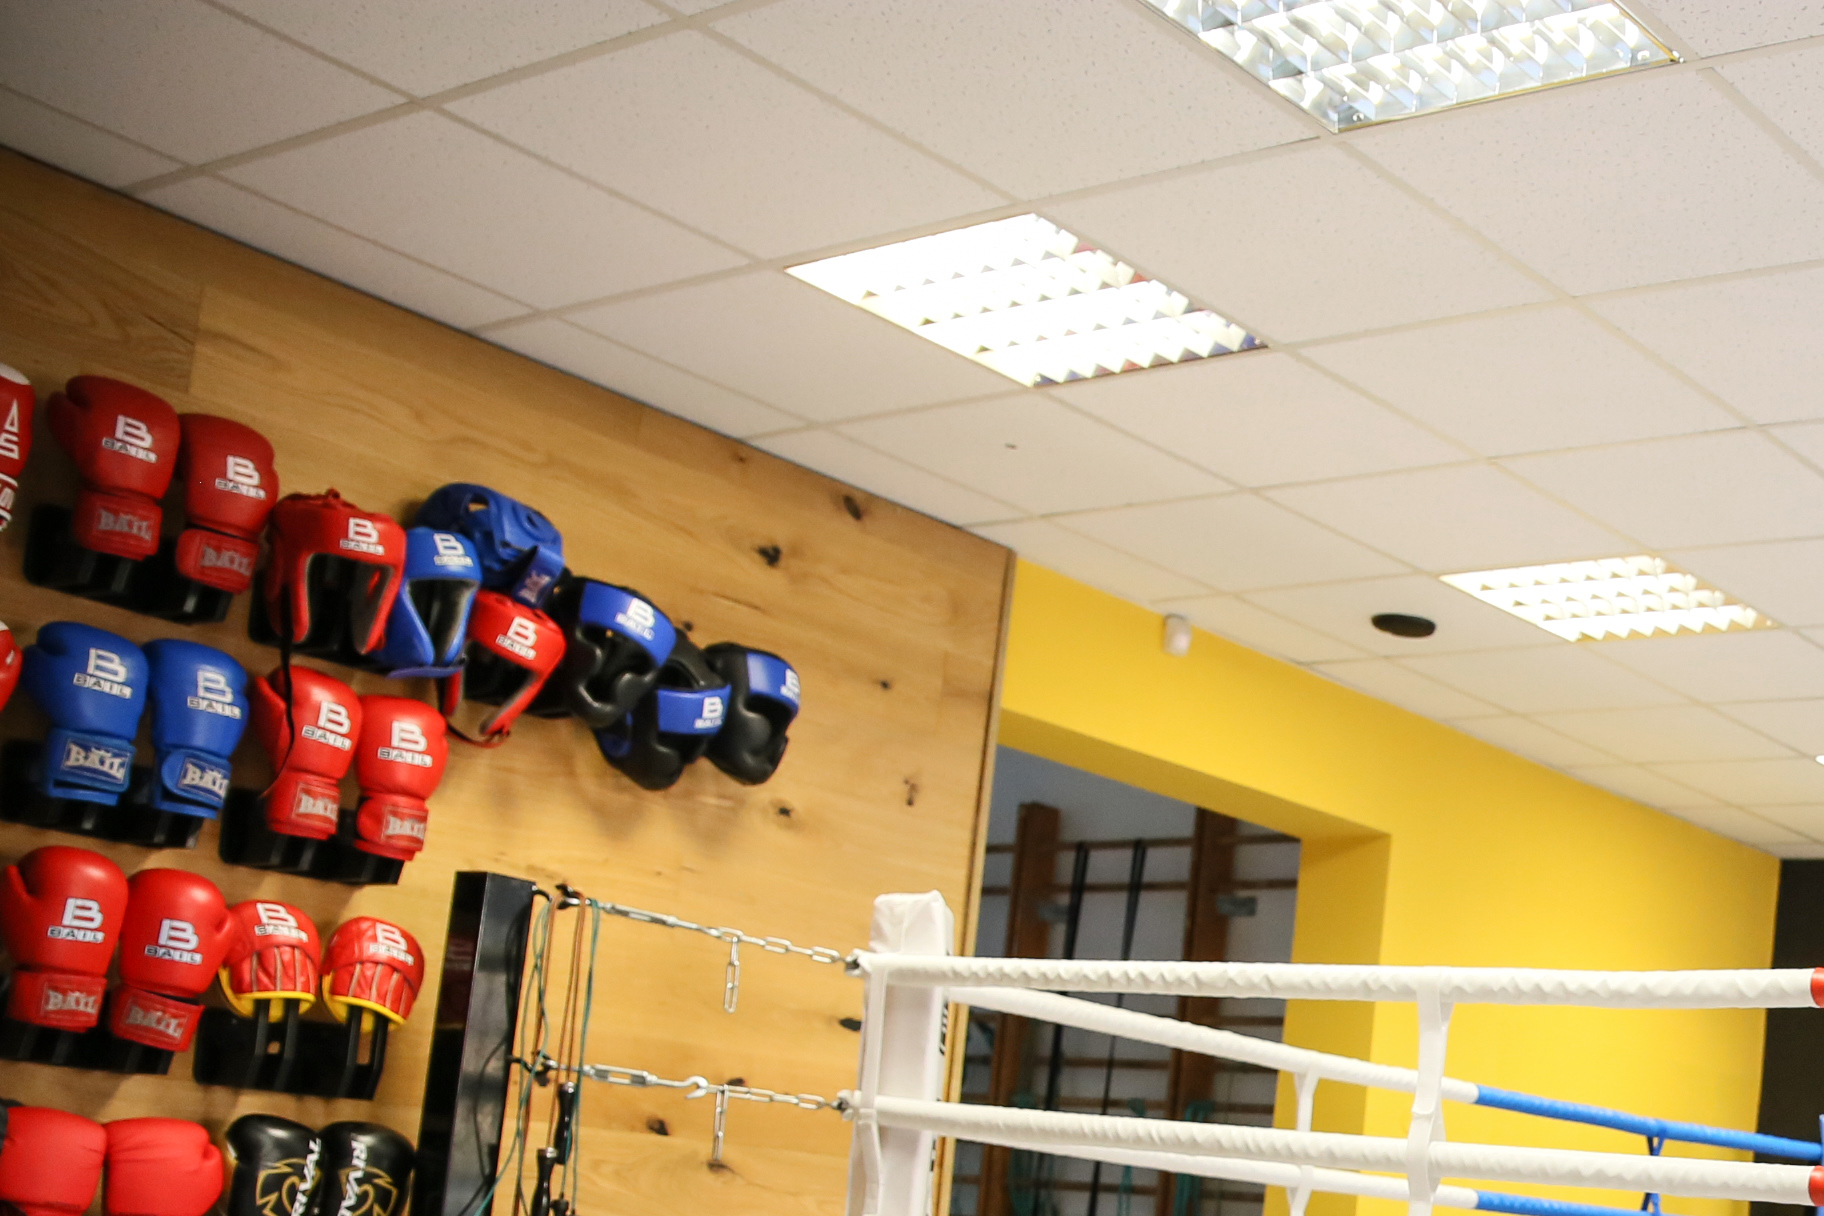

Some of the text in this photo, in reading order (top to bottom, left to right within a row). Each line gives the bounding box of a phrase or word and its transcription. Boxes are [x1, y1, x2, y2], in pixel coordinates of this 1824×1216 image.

[115, 414, 154, 449] B
[102, 437, 158, 463] BAIL
[226, 455, 260, 486] B
[215, 478, 266, 499] BAIL
[348, 517, 379, 543] B
[340, 539, 384, 555] BAIL
[433, 533, 465, 555] B
[626, 598, 655, 628] B
[508, 616, 538, 646] B
[87, 647, 127, 683] B
[73, 672, 133, 699] BAIL
[197, 670, 233, 703] B
[187, 696, 241, 720] BAIL
[317, 700, 351, 735] B
[702, 696, 723, 718] B
[302, 724, 352, 751] BAIL
[391, 720, 427, 752] B
[63, 743, 127, 781] BAIL
[378, 746, 433, 768] BAIL
[62, 897, 104, 930] B
[256, 902, 298, 928] B
[47, 925, 105, 944] BAIL
[158, 918, 199, 951] B
[375, 922, 408, 950] B
[145, 945, 203, 966] BAIL
[44, 989, 97, 1015] BAIL
[125, 1004, 183, 1039] BAIL
